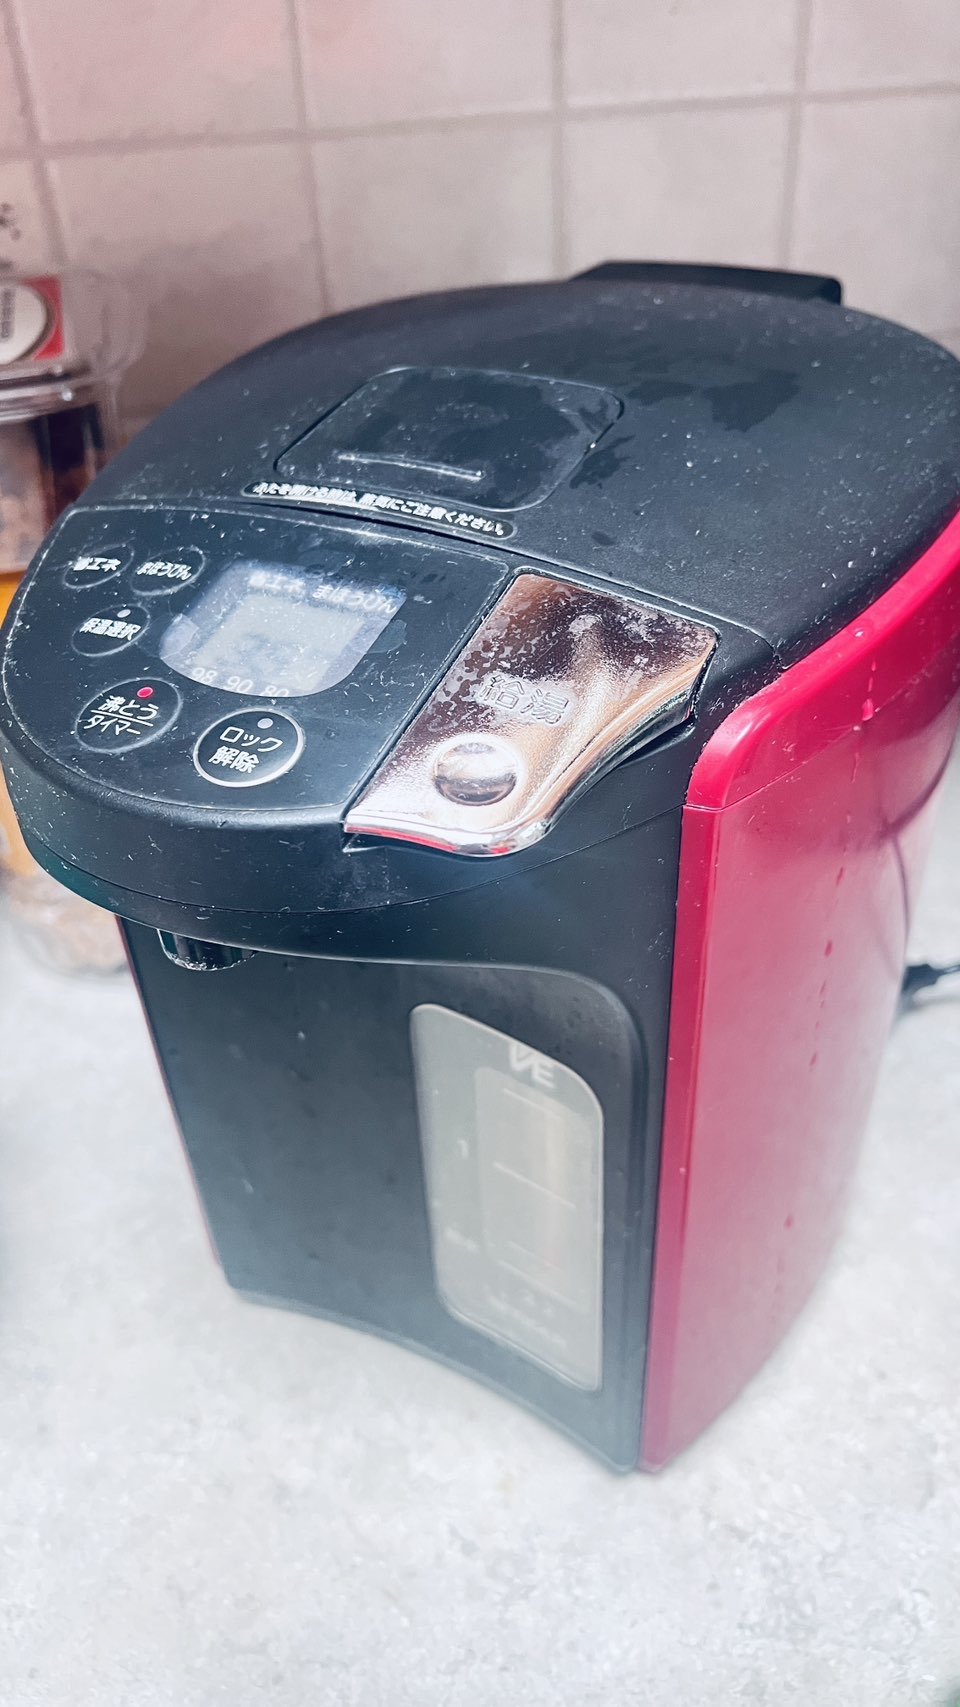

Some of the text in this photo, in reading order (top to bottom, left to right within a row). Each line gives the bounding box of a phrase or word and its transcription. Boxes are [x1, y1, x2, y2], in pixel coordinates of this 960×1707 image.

[79, 617, 142, 641] 保温選択
[224, 676, 255, 694] 90
[98, 694, 160, 721] 沸とう
[479, 674, 570, 725] 給湯
[83, 714, 142, 736] タイマー
[219, 725, 283, 752] ロック
[208, 745, 260, 774] 解除
